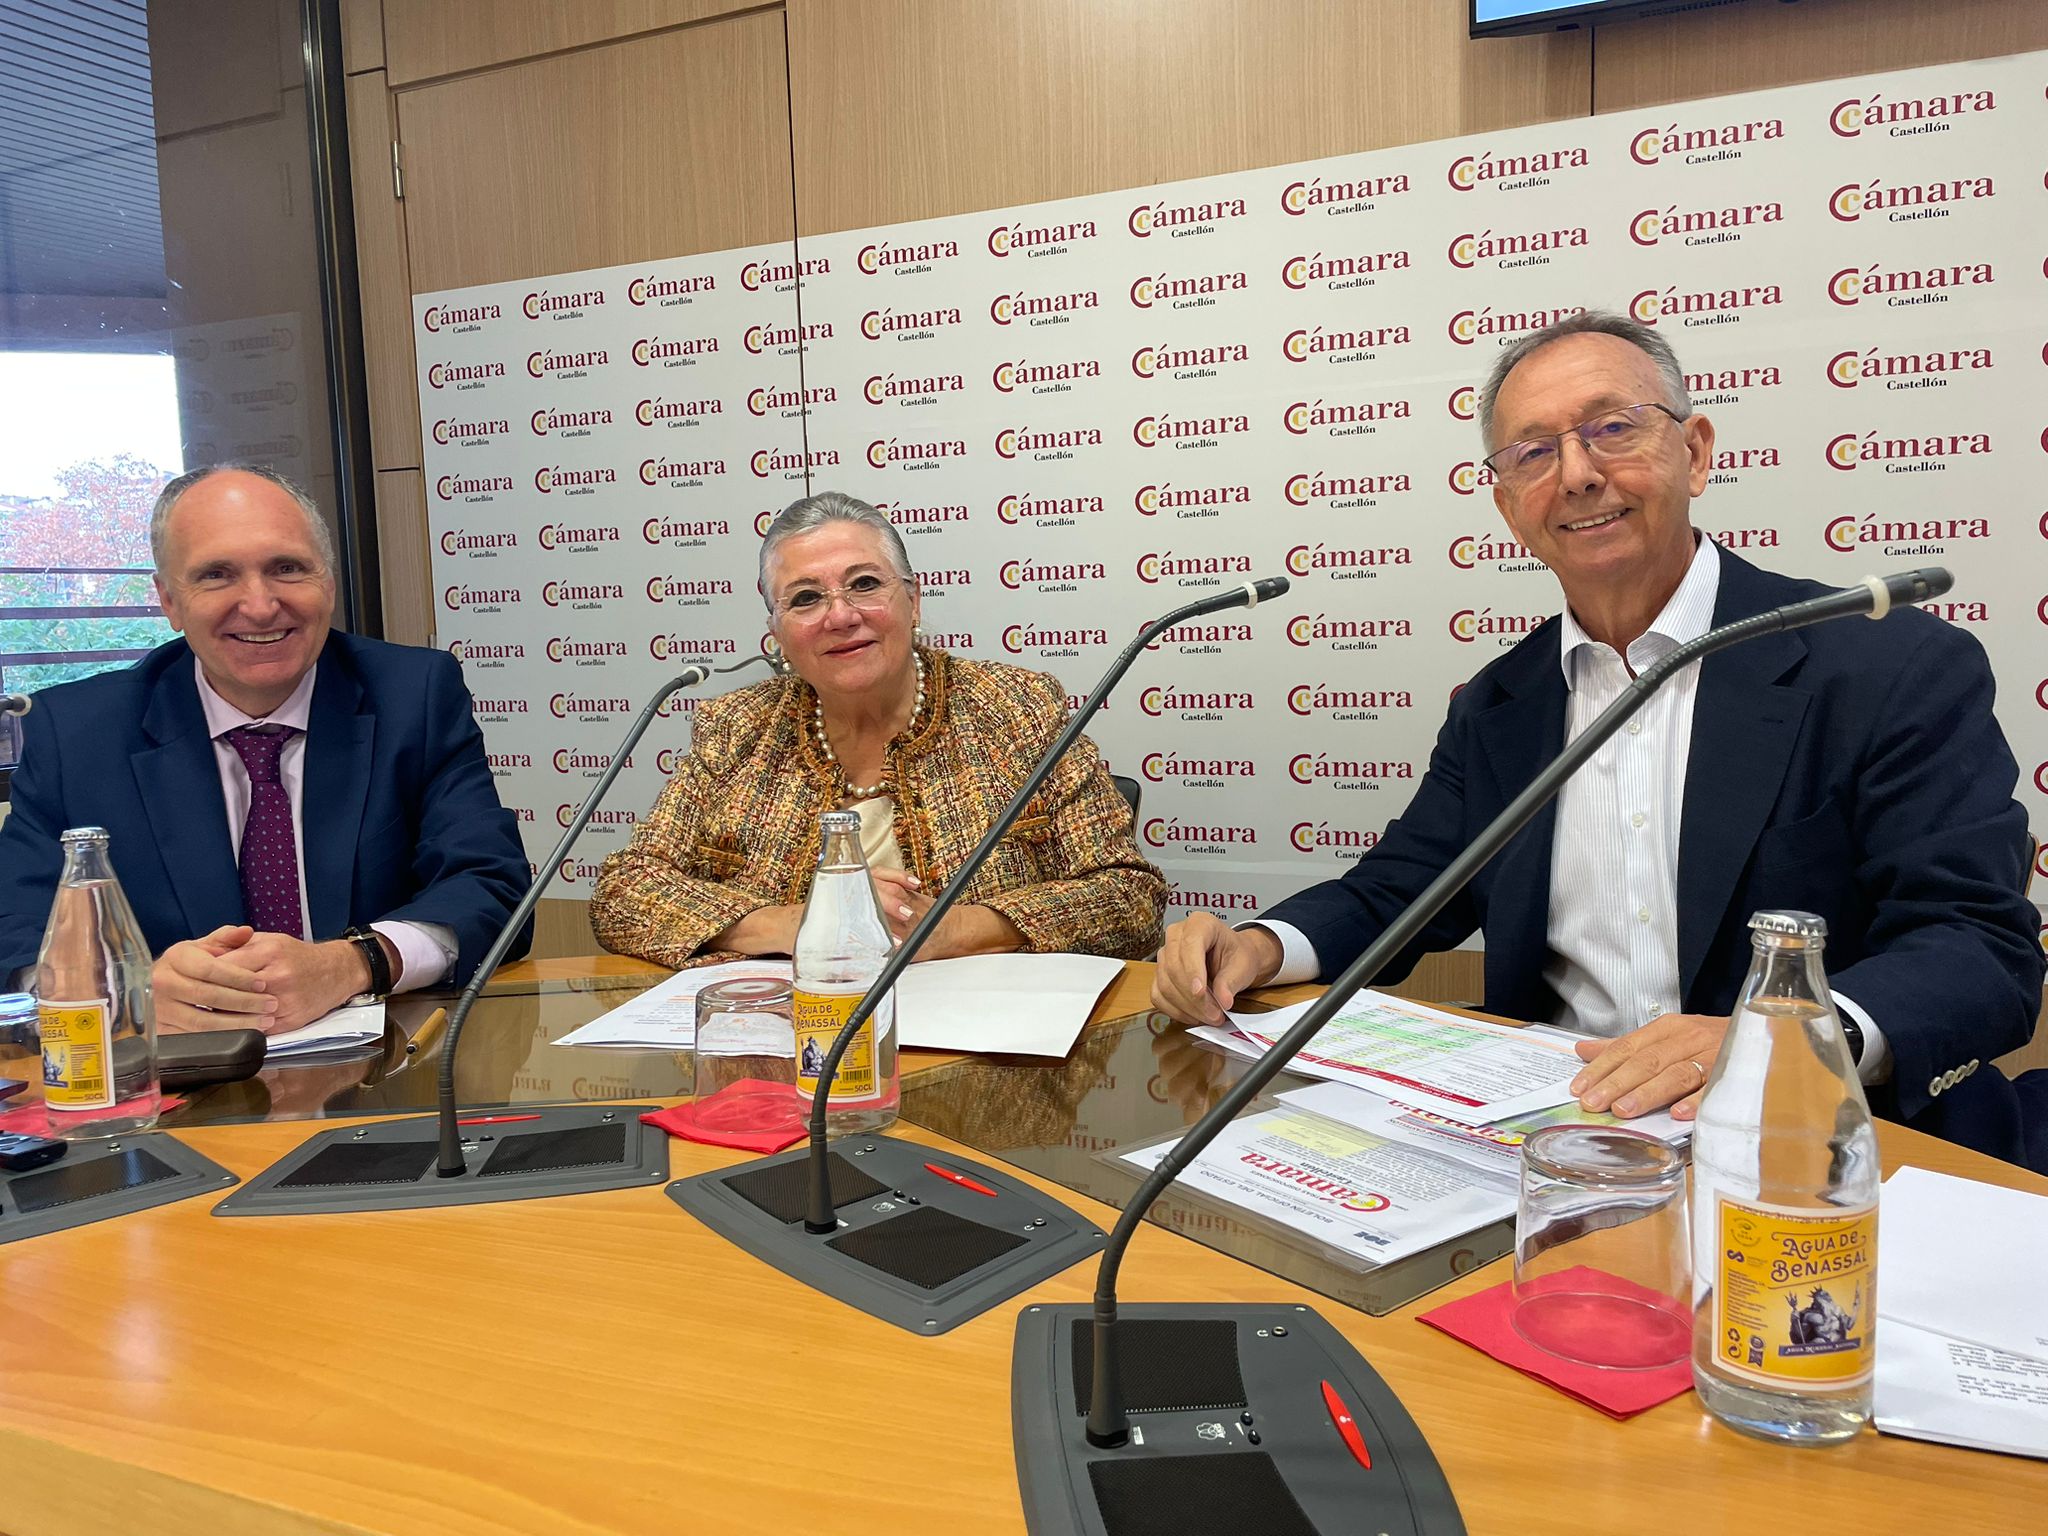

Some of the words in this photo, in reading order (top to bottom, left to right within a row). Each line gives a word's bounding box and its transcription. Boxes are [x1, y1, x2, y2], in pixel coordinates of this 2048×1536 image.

[1829, 90, 1998, 138] Cámara
[1629, 119, 1785, 166] Cámara
[1889, 121, 1950, 138] Castellón
[1447, 147, 1590, 192] Cámara
[1685, 149, 1742, 166] Castellón
[1280, 174, 1411, 216] Cámara
[1498, 176, 1550, 192] Castellón
[1327, 201, 1375, 217] Castellón
[1828, 177, 1997, 223] Cámara
[1888, 207, 1950, 223] Castellón
[1128, 199, 1248, 239] Cámara
[1170, 224, 1215, 239] Castellón
[1629, 202, 1785, 247] Cámara
[987, 221, 1098, 258] Cámara
[1027, 245, 1068, 259] Castellón
[1447, 227, 1590, 269] Cámara
[1684, 231, 1741, 247] Castellón
[857, 241, 960, 276] Cámara
[894, 264, 932, 277] Castellón
[1281, 250, 1412, 290] Cámara
[1498, 255, 1550, 270] Castellón
[627, 274, 717, 307] Cámara
[1129, 272, 1249, 309] Cámara
[1327, 277, 1376, 291] Castellón
[1827, 263, 1996, 306] Cámara
[522, 289, 606, 321] Cámara
[990, 290, 1100, 326] Cámara
[1172, 296, 1216, 310] Castellón
[1629, 285, 1784, 328] Cámara
[1887, 292, 1949, 308] Castellón
[423, 303, 502, 333] Cámara
[860, 306, 963, 341] Cámara
[1029, 314, 1070, 327] Castellón
[1683, 313, 1740, 328] Castellón
[631, 335, 720, 367] Cámara
[897, 330, 935, 343] Castellón
[1282, 325, 1412, 363] Cámara
[526, 348, 610, 379] Cámara
[1131, 343, 1250, 379] Cámara
[1328, 351, 1376, 365] Castellón
[1826, 346, 1995, 389] Cámara
[427, 360, 506, 390] Cámara
[863, 372, 966, 406] Cámara
[992, 358, 1102, 393] Cámara
[1031, 383, 1072, 395] Castellón
[1173, 368, 1217, 381] Castellón
[1682, 365, 1783, 394] mara
[1886, 376, 1948, 391] Castellón
[635, 396, 724, 427] Cámara
[900, 396, 938, 408] Castellón
[1690, 393, 1740, 407] astellón
[432, 416, 510, 446] Cámara
[530, 406, 614, 437] Cámara
[1133, 413, 1251, 448] Cámara
[1283, 398, 1412, 435] Cámara
[1329, 424, 1376, 438] Castellón
[866, 436, 967, 470] Cámara
[994, 425, 1103, 460] Cámara
[1033, 450, 1074, 462] Castellón
[1175, 438, 1218, 450] Castellón
[1825, 429, 1993, 471] Cámara
[534, 464, 617, 494] Cámara
[638, 456, 727, 487] Cámara
[902, 461, 940, 472] Castellón
[1885, 460, 1946, 474] Castellón
[436, 472, 515, 502] Cámara
[1134, 482, 1252, 517] Cámara
[1284, 470, 1413, 507] Cámara
[996, 492, 1105, 525] Cámara
[1176, 508, 1220, 520] Castellón
[1329, 497, 1377, 509] Castellón
[538, 522, 621, 551] Cámara
[642, 515, 730, 545] Cámara
[905, 525, 943, 536] Castellón
[1035, 517, 1076, 528] Castellón
[1824, 512, 1992, 553] Cámara
[440, 528, 518, 557] Cámara
[1883, 544, 1945, 557] Castellón
[999, 557, 1107, 590] Cámara
[1136, 550, 1253, 584] Cámara
[1285, 542, 1413, 580] Cámara
[1330, 569, 1377, 581] Castellón
[646, 574, 734, 604] Cámara
[913, 568, 972, 587] mara
[1037, 583, 1078, 593] Castellón
[1177, 576, 1221, 588] Castellón
[444, 583, 522, 611] Cámara
[542, 579, 625, 608] Cámara
[1001, 622, 1109, 654] Cámara
[1285, 612, 1414, 647] Cámara
[1448, 607, 1546, 643] Cáma
[545, 635, 628, 664] Cámara
[649, 632, 737, 662] Cámara
[1039, 648, 1080, 658] Castellón
[1179, 644, 1222, 655] Castellón
[1331, 641, 1378, 651] Castellón
[549, 691, 631, 719] Cámara
[1139, 684, 1255, 717] Cámara
[1287, 682, 1414, 717] Cámara
[1180, 711, 1224, 722] Castellón
[1332, 711, 1379, 721] Castellón
[552, 748, 635, 774] Cámaa
[1141, 751, 1256, 783] Cámara
[1288, 751, 1415, 785] Cámara
[1182, 778, 1225, 788] Castellón
[1333, 780, 1380, 791] Castellón
[1139, 816, 1258, 850] Cámara
[1289, 818, 1381, 853] Cáma
[1183, 844, 1227, 855] Castellón
[1167, 881, 1260, 912] ámara
[1239, 1151, 1392, 1214] Cámara
[1780, 1235, 1836, 1261] AGUA
